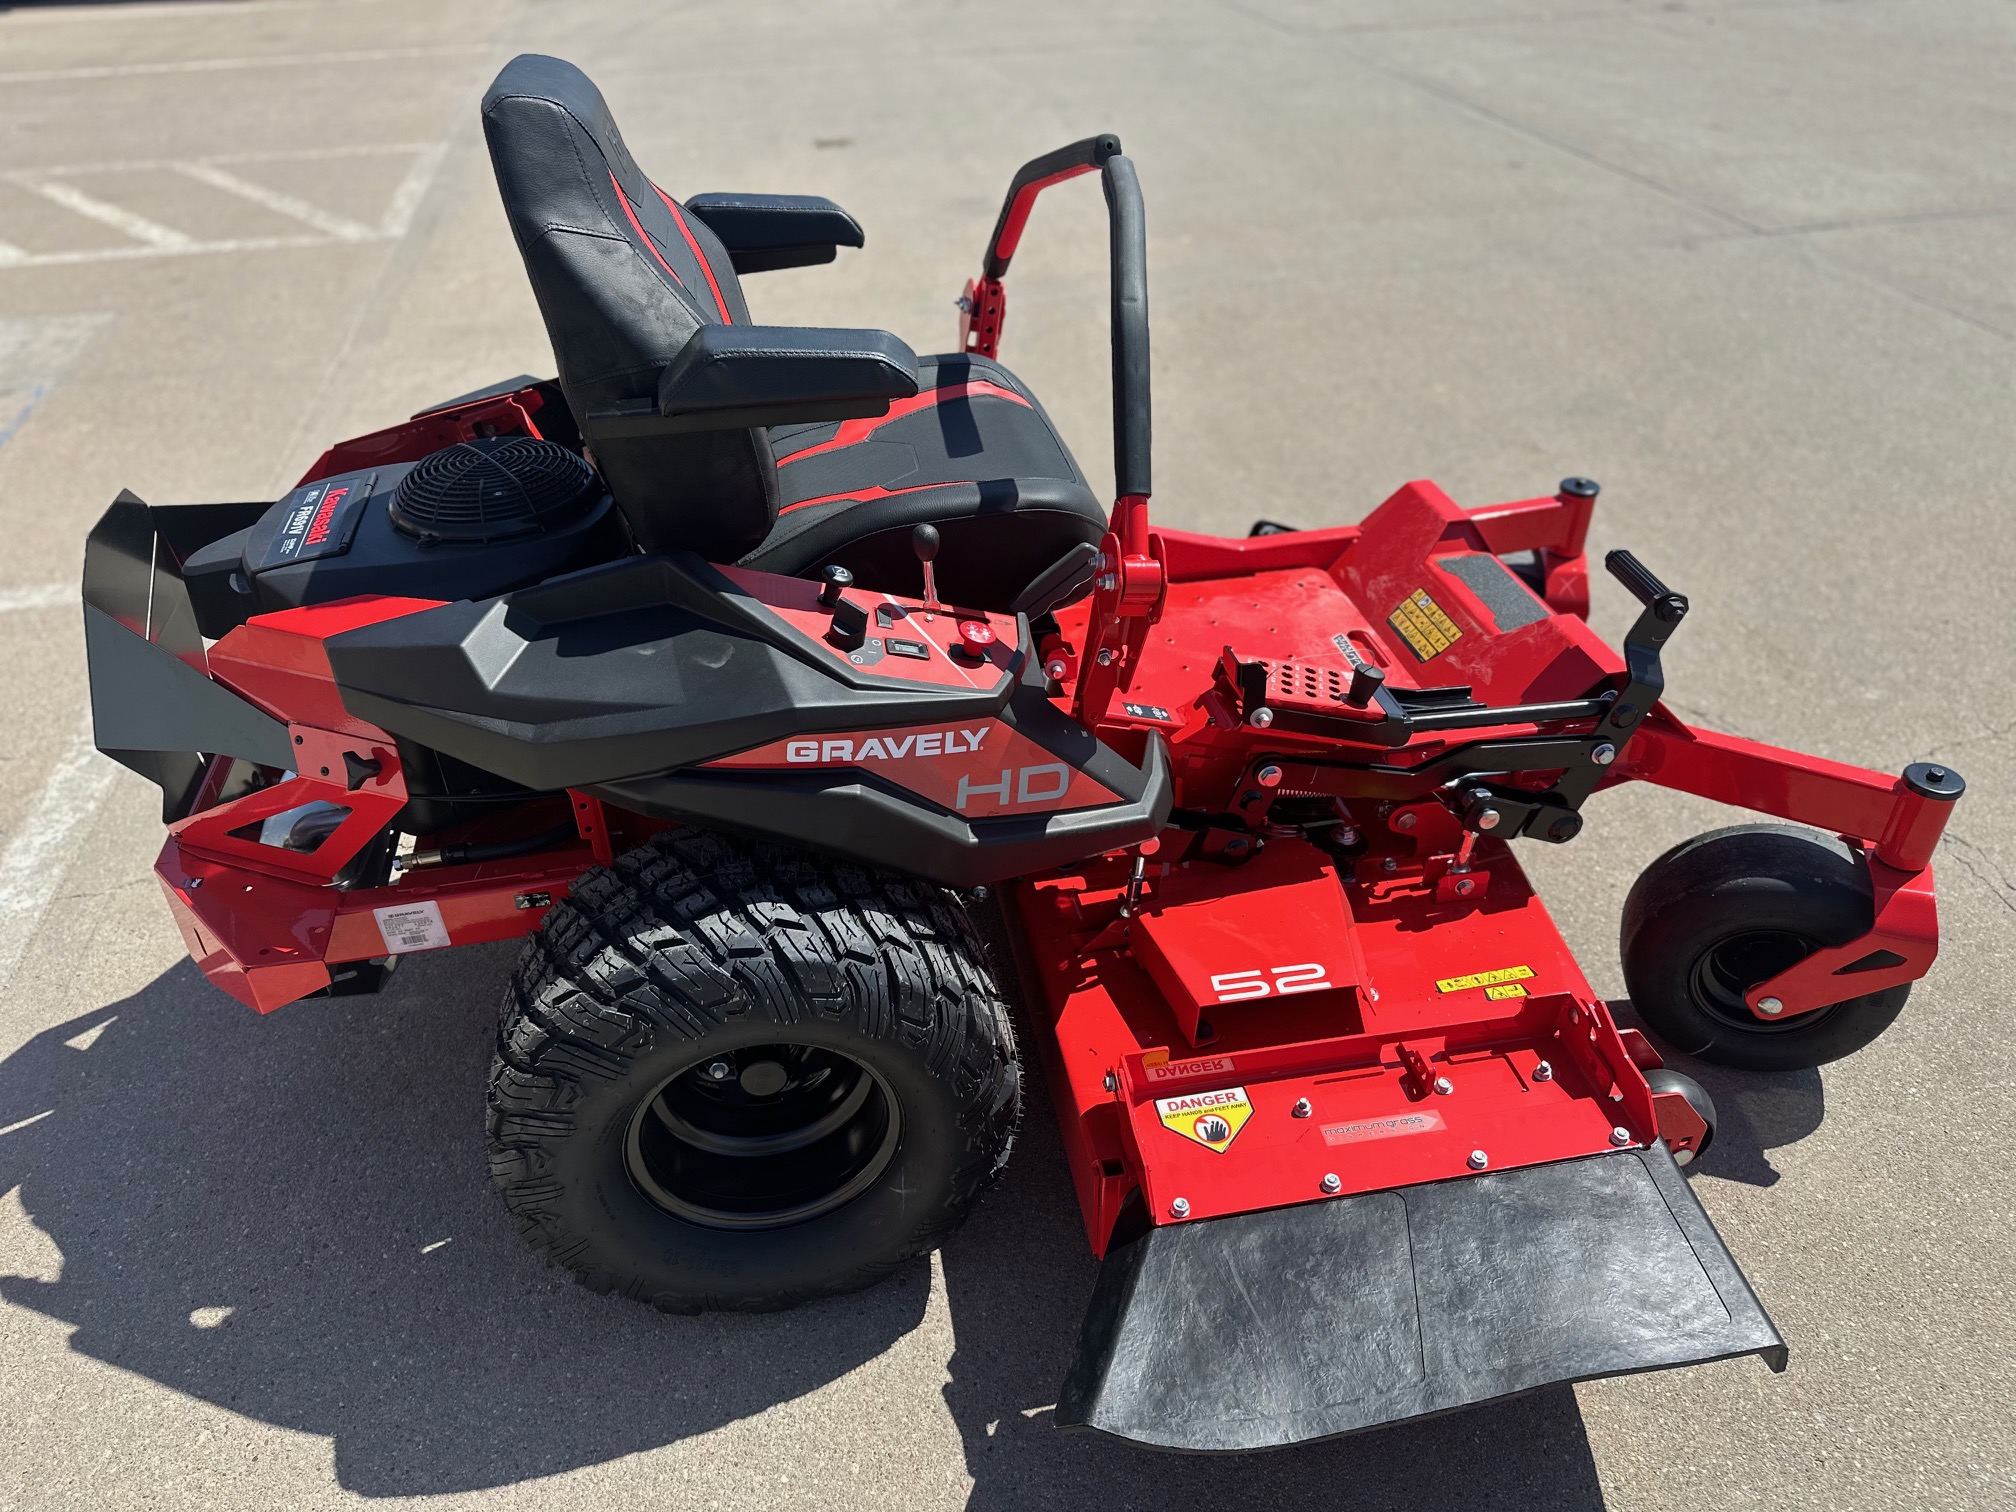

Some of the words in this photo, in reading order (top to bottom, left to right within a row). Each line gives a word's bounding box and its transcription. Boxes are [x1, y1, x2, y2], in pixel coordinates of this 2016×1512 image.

[288, 505, 314, 535] FR691V
[305, 487, 349, 545] Kawasaki
[786, 726, 990, 763] GRAVELY
[955, 762, 1070, 810] HD
[1210, 963, 1332, 1002] 52
[1166, 1092, 1239, 1112] DANGER
[1215, 1104, 1230, 1112] FEET
